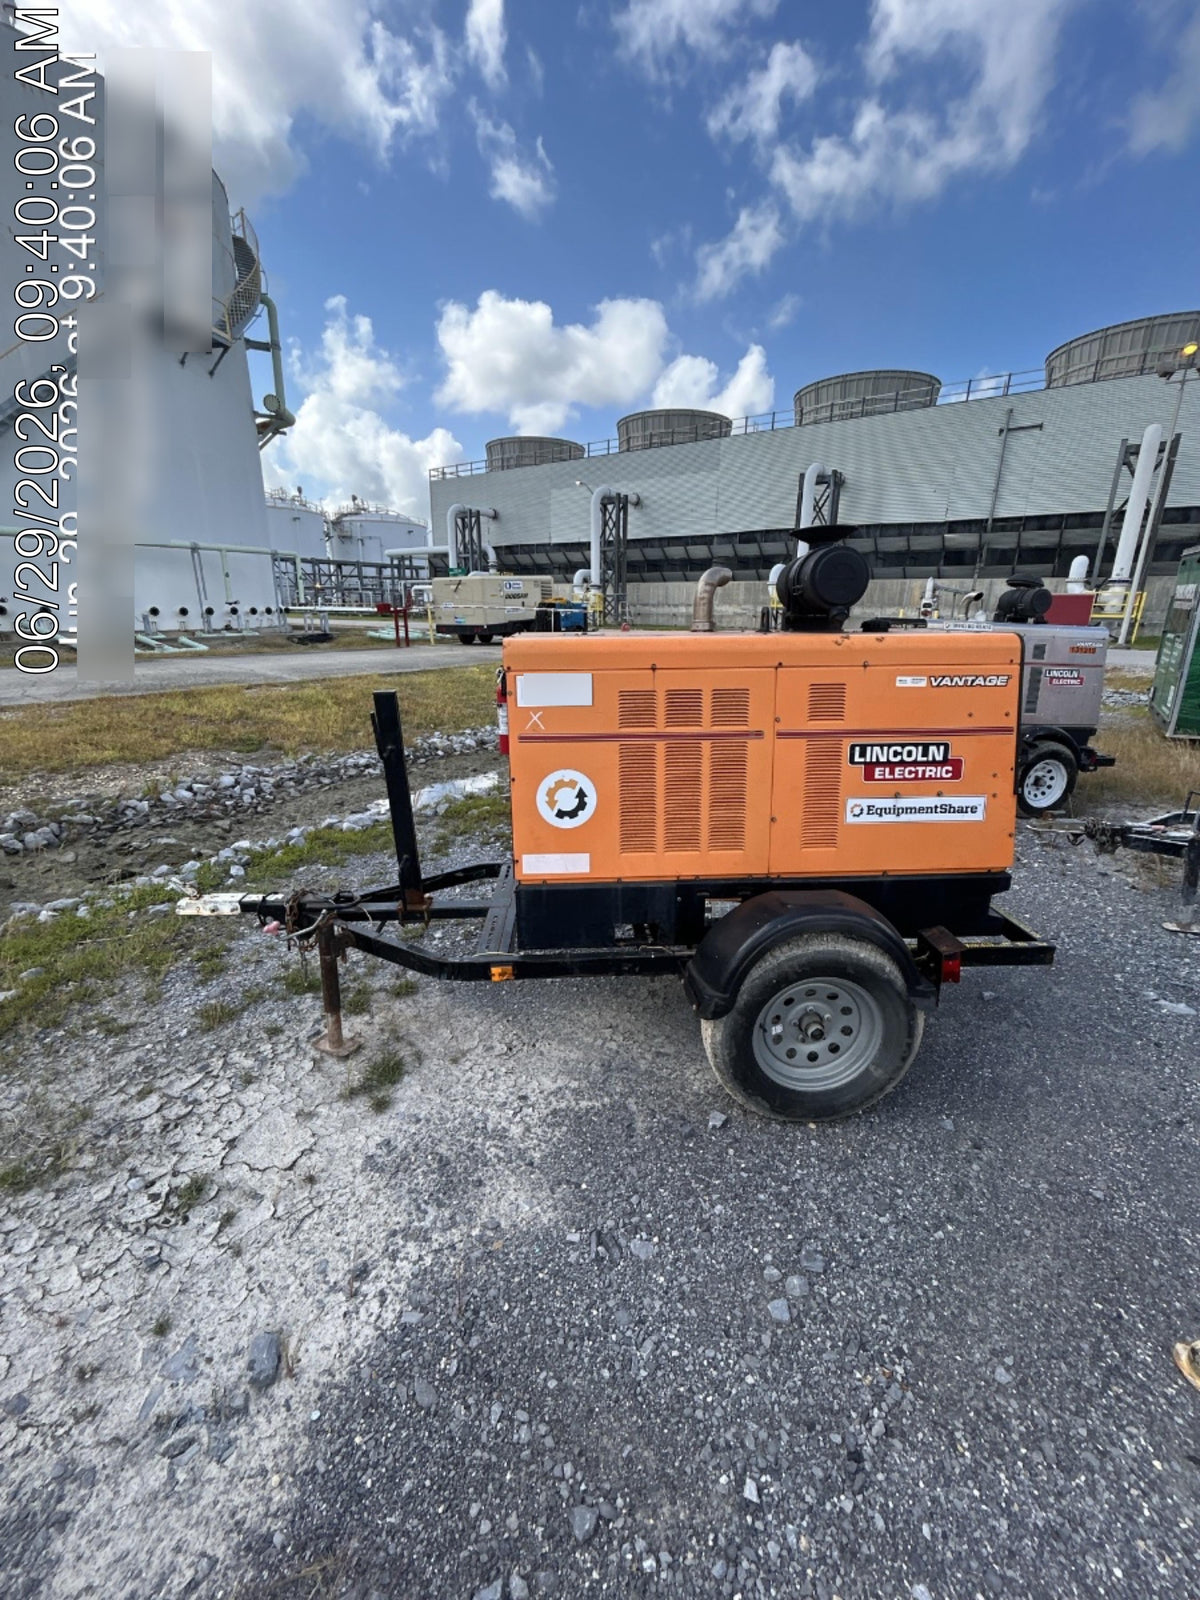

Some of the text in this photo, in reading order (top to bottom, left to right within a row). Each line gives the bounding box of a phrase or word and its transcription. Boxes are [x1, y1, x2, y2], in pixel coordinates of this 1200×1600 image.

[1046, 670, 1078, 678] LINCOLN
[929, 675, 1010, 687] VANTAGE
[853, 745, 945, 763] LINCOLN
[874, 766, 953, 779] ELECTRIC
[866, 804, 979, 817] EquipmentShare
